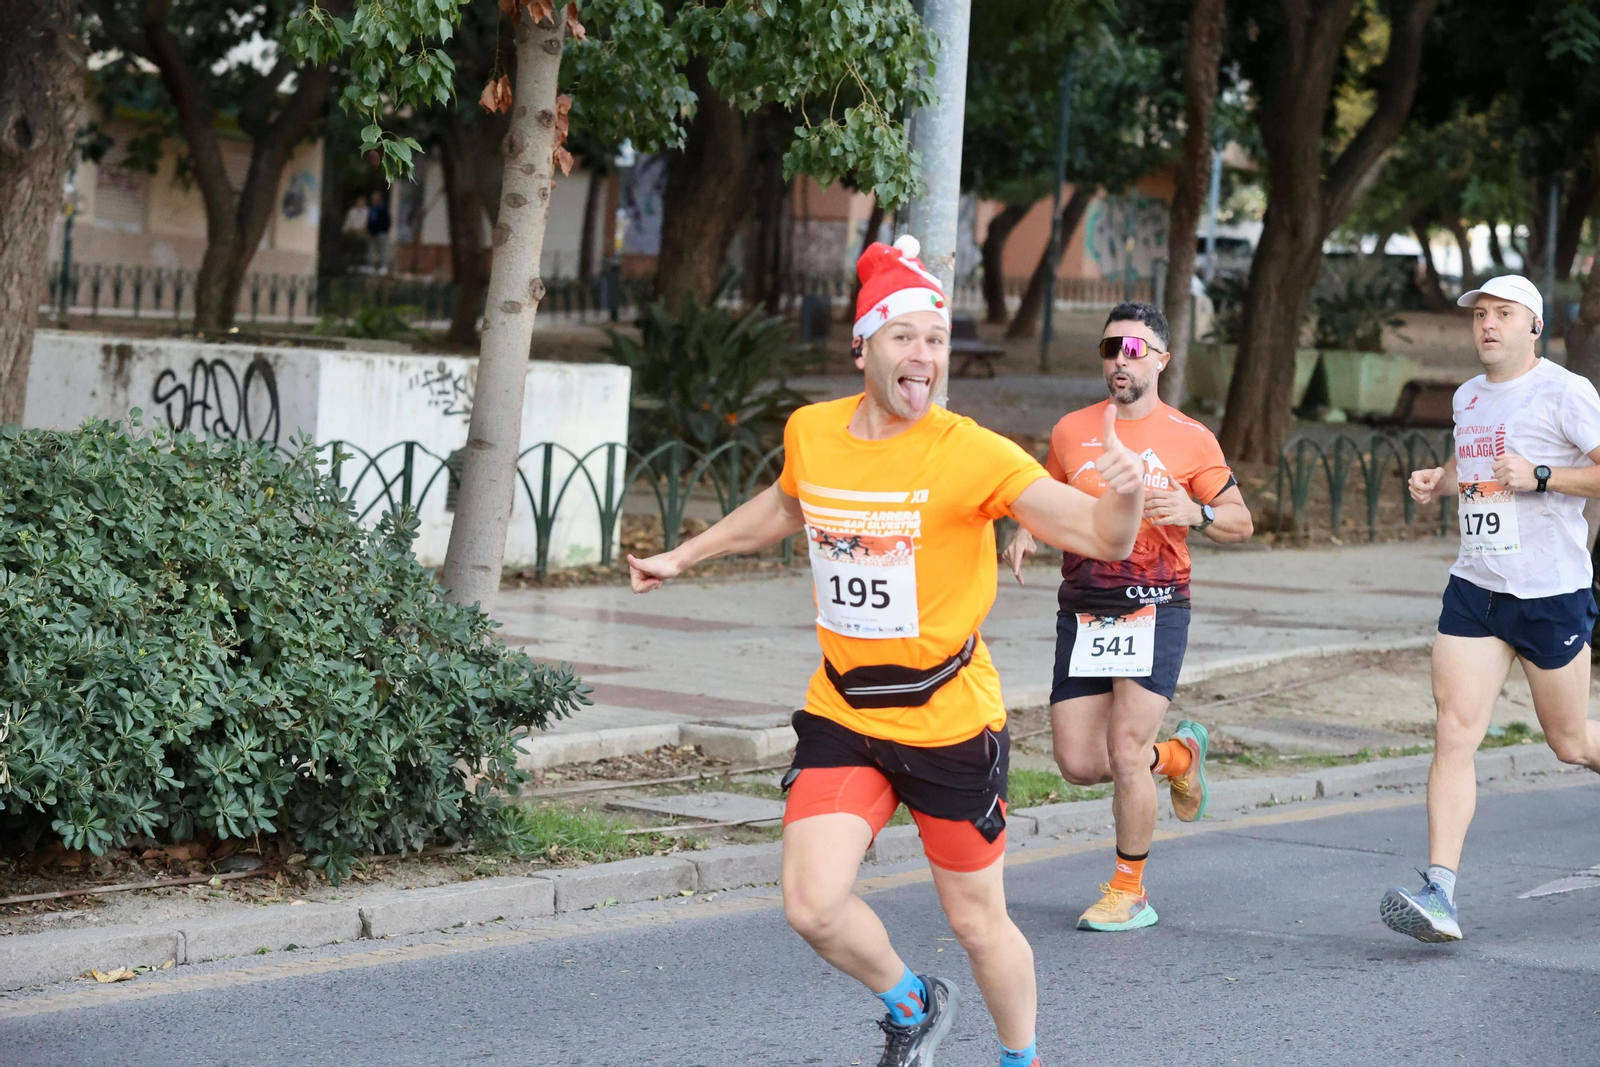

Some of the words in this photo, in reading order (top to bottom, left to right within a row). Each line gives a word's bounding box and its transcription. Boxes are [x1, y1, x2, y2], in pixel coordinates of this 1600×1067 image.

[1458, 442, 1495, 459] MÁLAGA
[863, 510, 921, 521] CARRERA
[1464, 512, 1500, 535] 179
[829, 575, 891, 609] 195
[1091, 636, 1136, 657] 541
